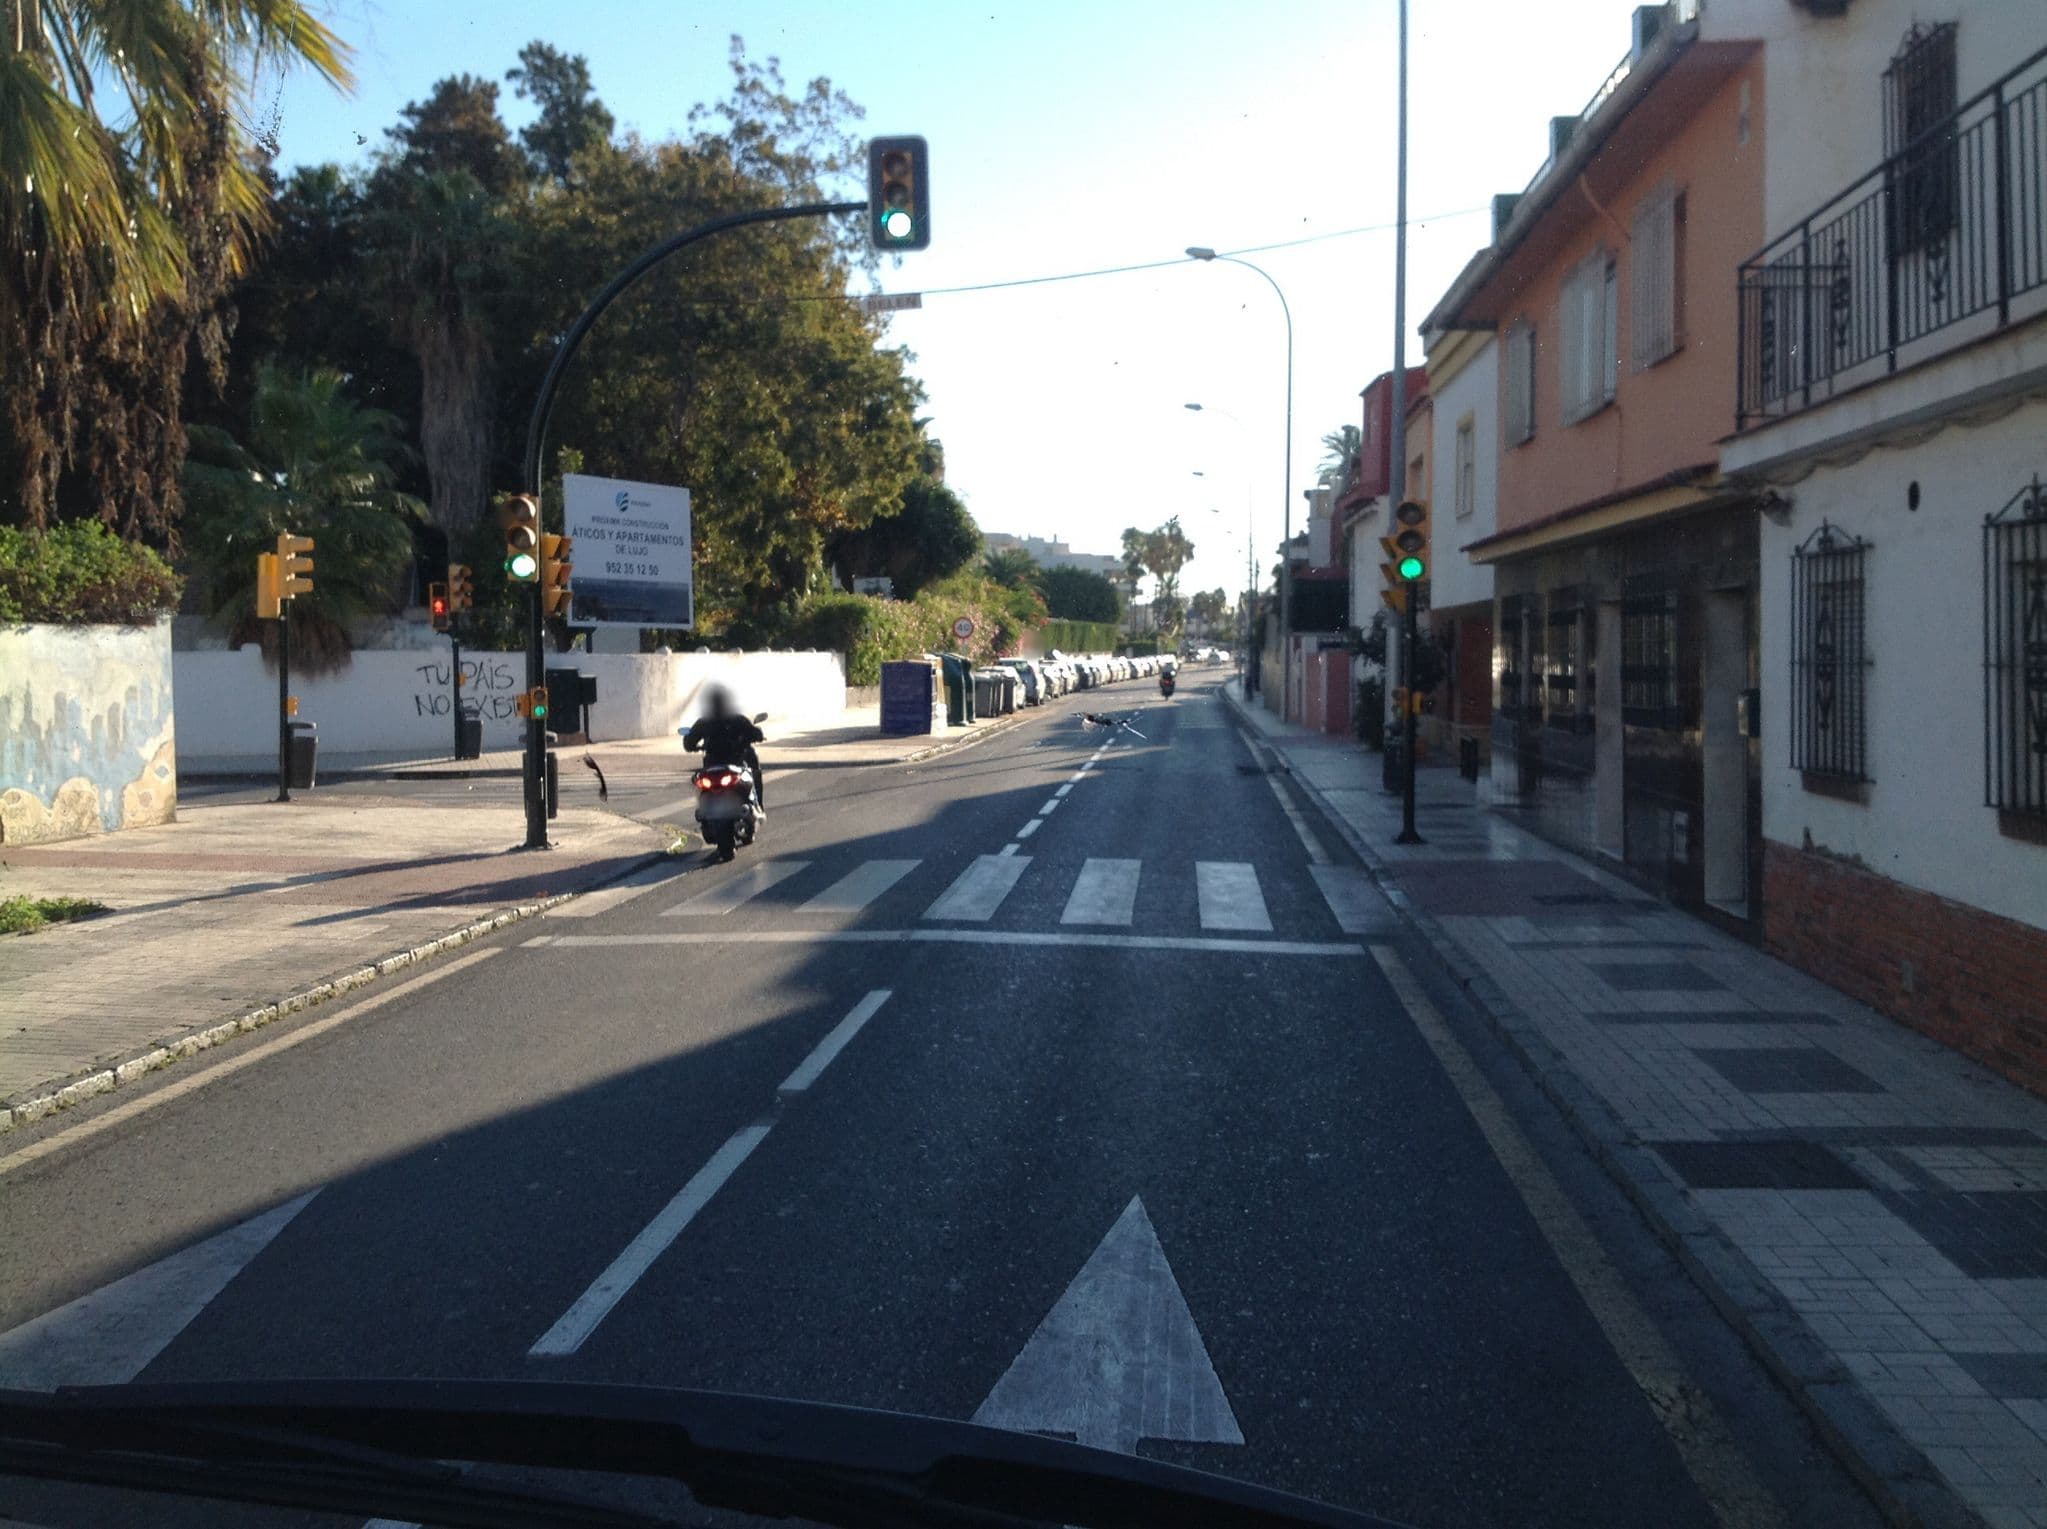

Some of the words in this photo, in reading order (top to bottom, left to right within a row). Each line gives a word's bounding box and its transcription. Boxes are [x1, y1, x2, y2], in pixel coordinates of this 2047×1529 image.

[608, 530, 614, 540] Y
[616, 531, 684, 546] APARTAMENTOS
[616, 544, 625, 554] DE
[628, 545, 648, 556] LUJO
[637, 564, 646, 575] 12
[415, 693, 450, 716] NO
